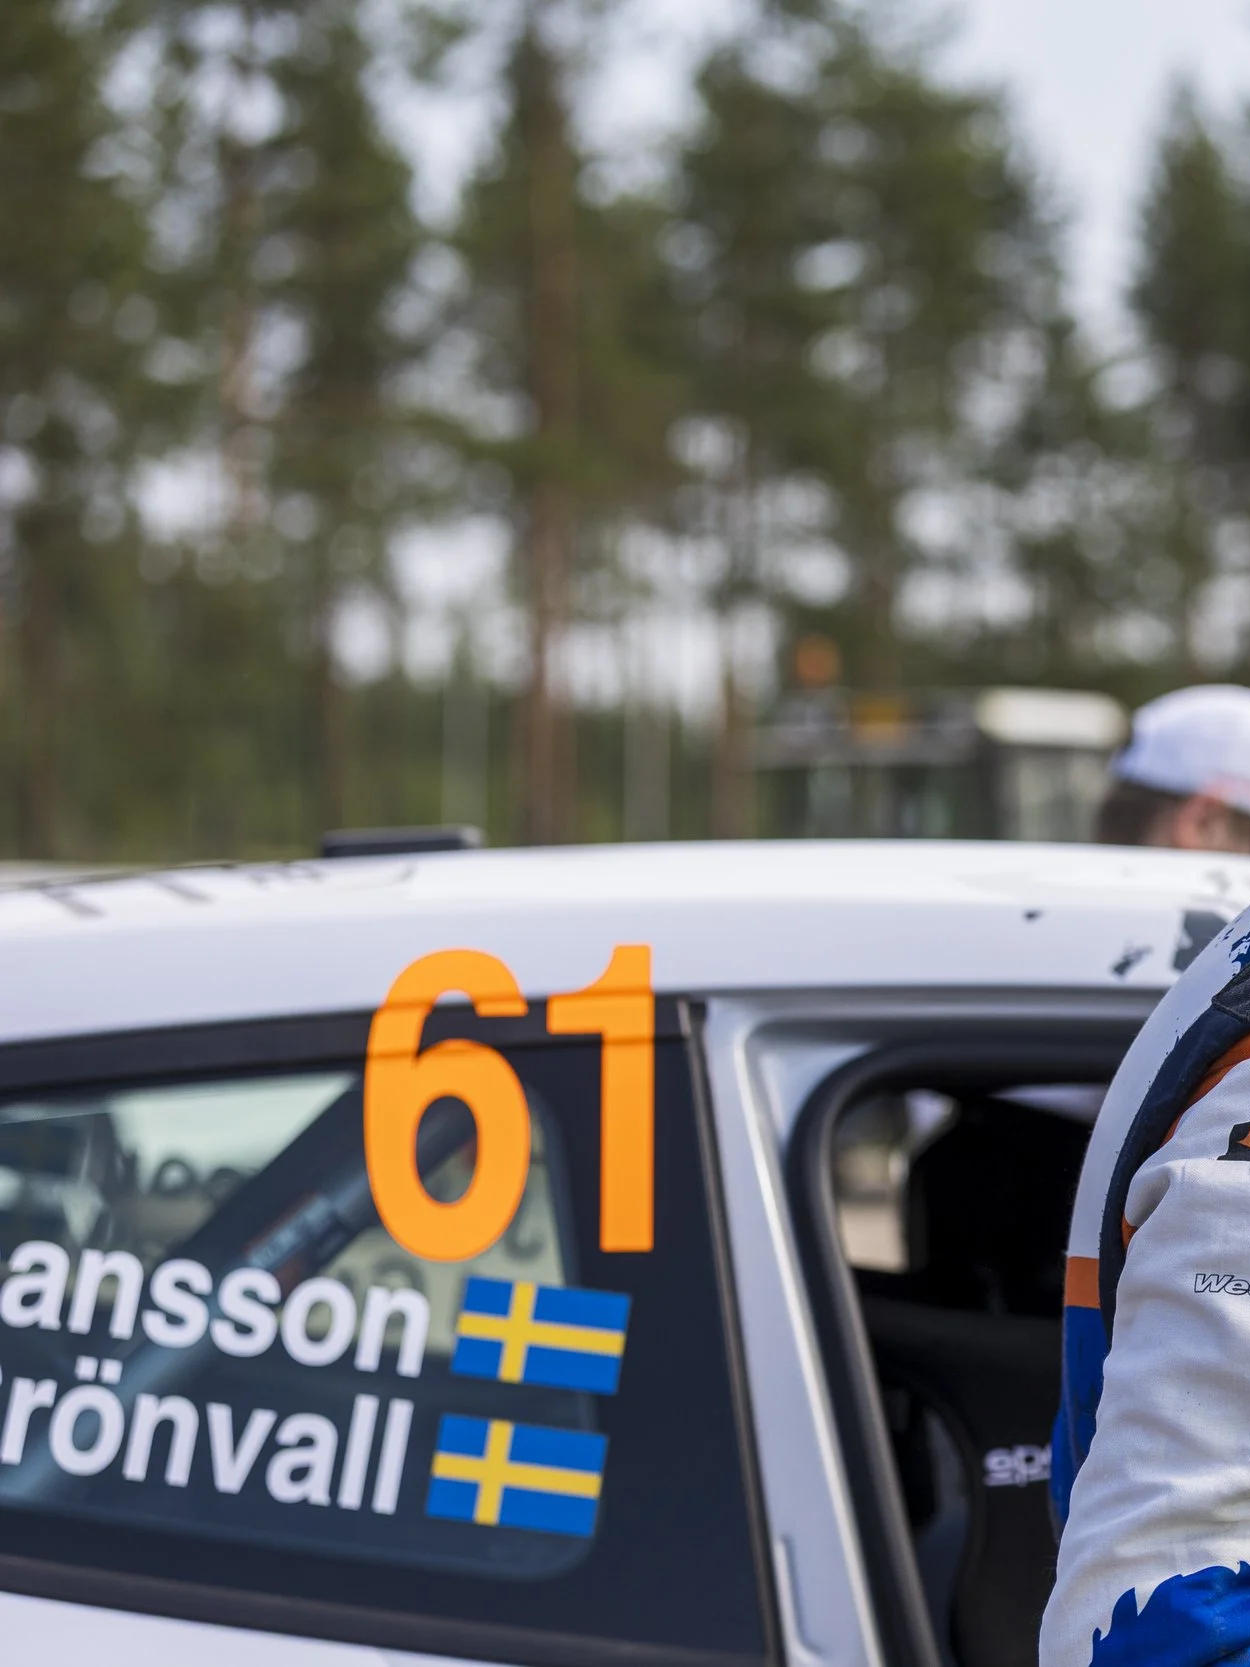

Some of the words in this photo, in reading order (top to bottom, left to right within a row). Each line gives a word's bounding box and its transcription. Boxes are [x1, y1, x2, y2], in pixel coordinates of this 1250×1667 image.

[363, 943, 656, 1263] 61
[0, 1240, 431, 1378] ansson
[0, 1355, 414, 1516] rönvall
